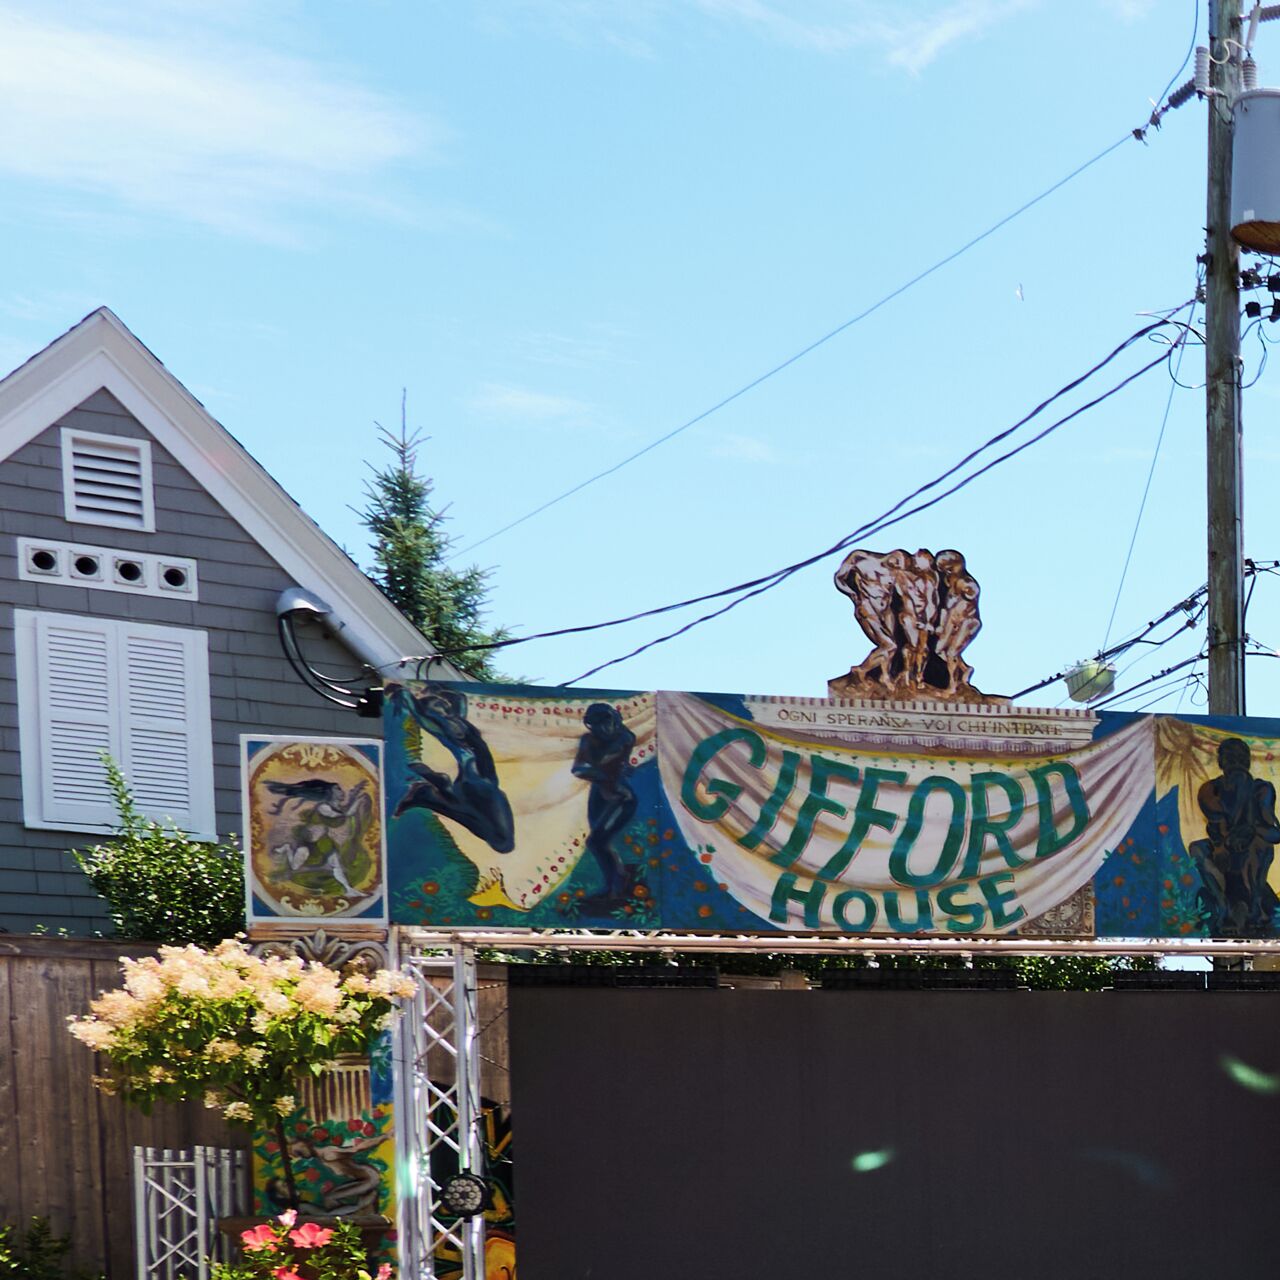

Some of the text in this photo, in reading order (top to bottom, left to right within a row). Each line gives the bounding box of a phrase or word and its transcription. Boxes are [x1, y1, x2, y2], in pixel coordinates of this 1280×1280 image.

[777, 708, 817, 723] OGNI
[921, 718, 952, 732] VOI
[681, 727, 1092, 889] GIFFORD
[768, 871, 1029, 933] HOUSE
